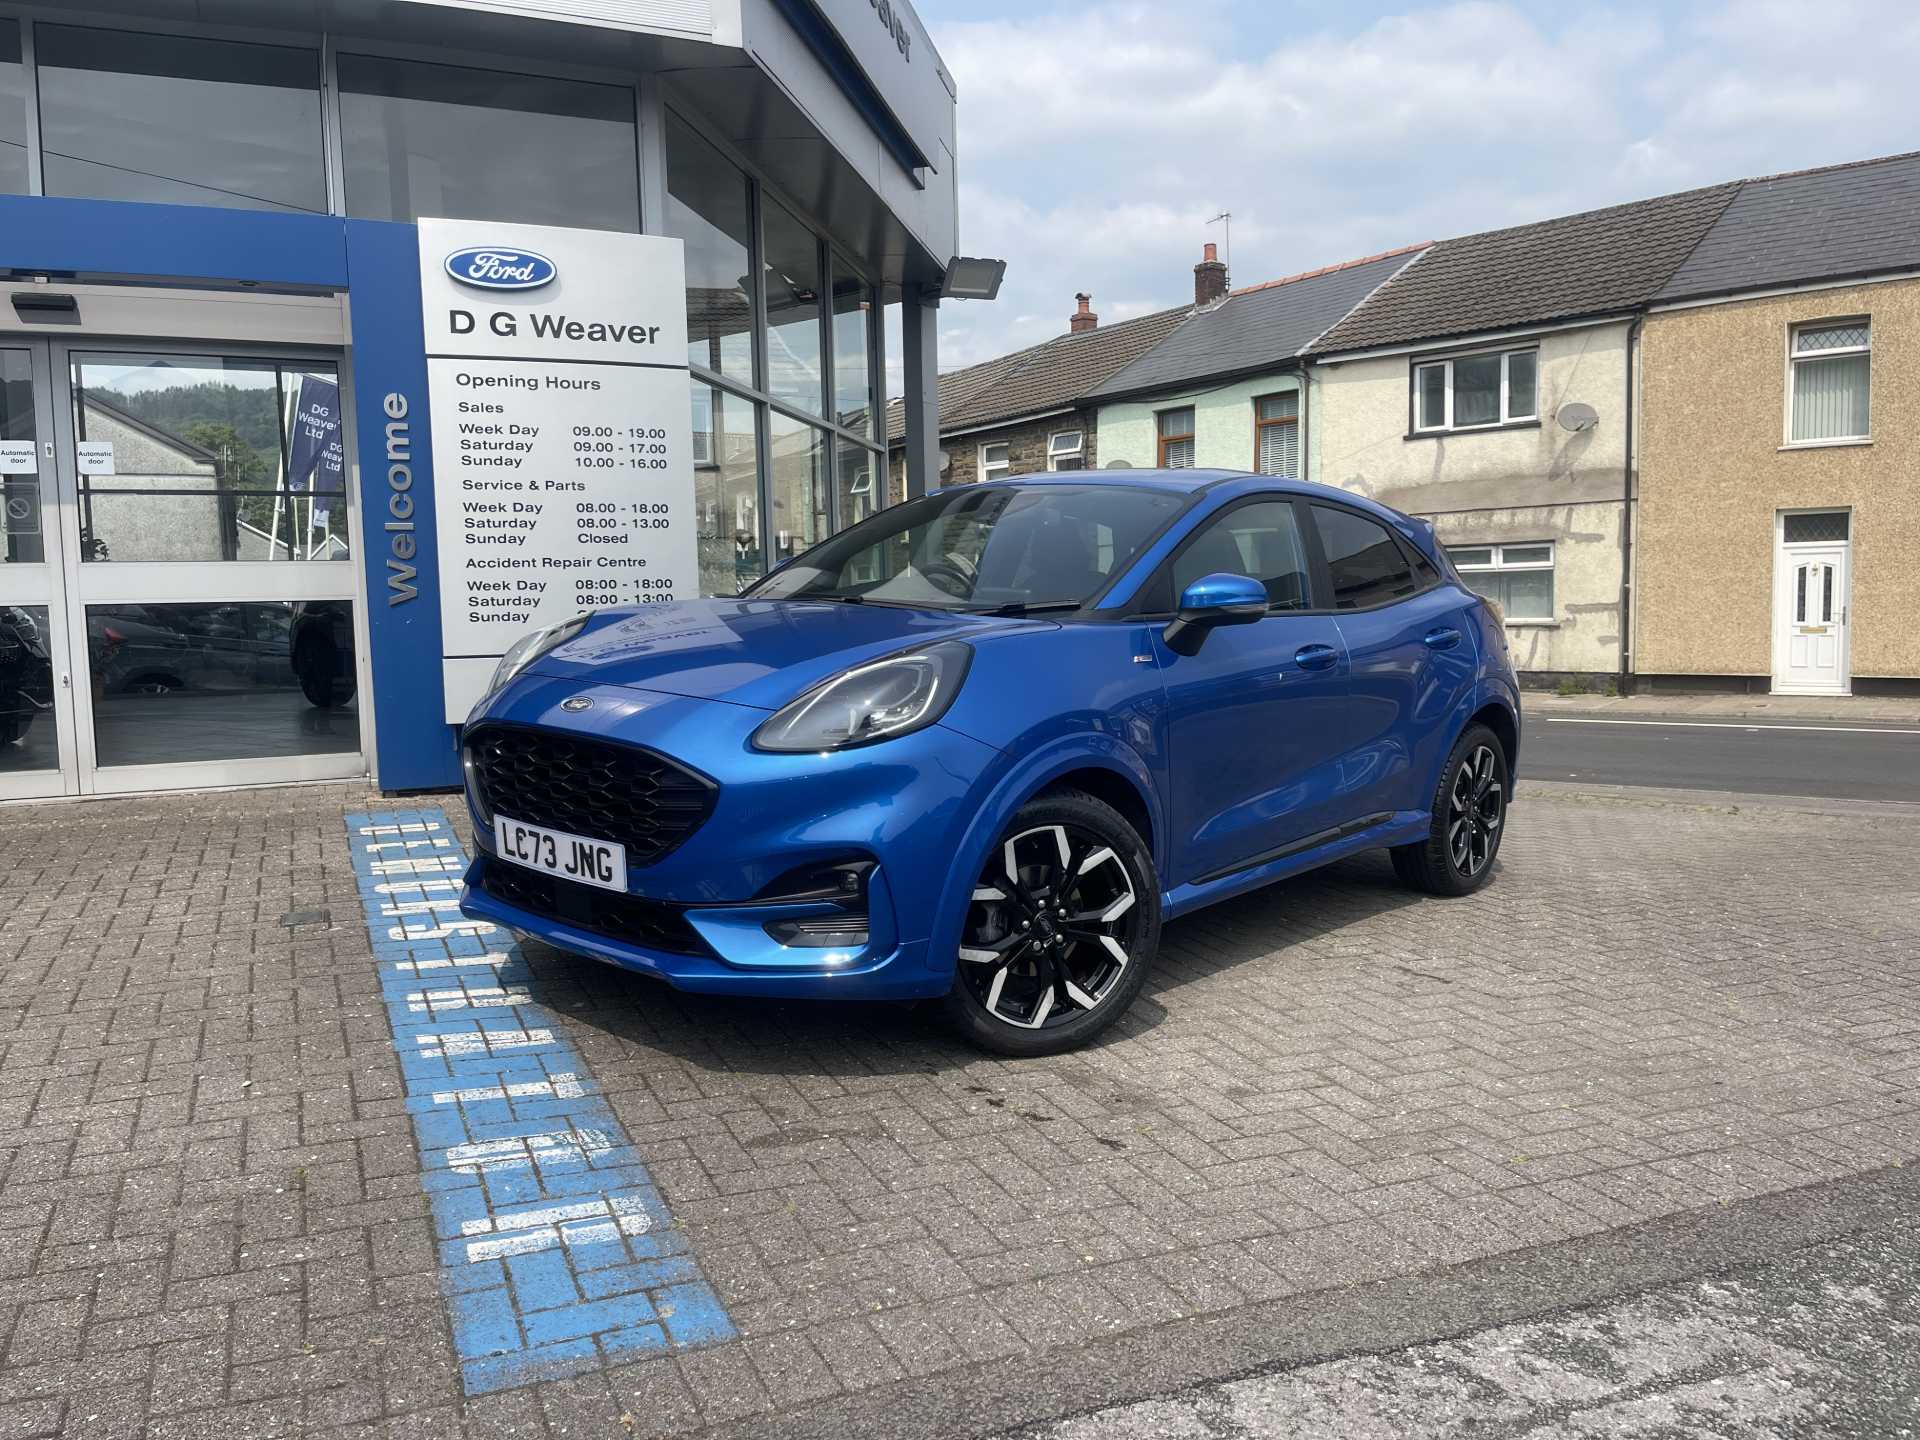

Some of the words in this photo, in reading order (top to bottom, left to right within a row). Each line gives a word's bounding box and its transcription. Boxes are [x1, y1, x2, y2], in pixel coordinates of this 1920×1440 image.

[869, 0, 911, 64] aver
[468, 252, 536, 282] Ford
[449, 309, 476, 335] D
[489, 311, 518, 337] G
[529, 313, 661, 345] Weaver
[455, 372, 539, 391] Opening
[545, 375, 601, 391] Hours
[311, 403, 329, 417] DG
[458, 401, 504, 414] Sales
[304, 425, 325, 440] Ltd
[458, 423, 504, 435] Week
[509, 423, 540, 438] Day
[572, 425, 613, 438] 09.00
[628, 427, 666, 440] 19.00
[0, 449, 36, 457] Automatic
[78, 450, 113, 458] Automatic
[330, 442, 343, 453] DG
[460, 438, 534, 454] Saturday
[573, 441, 614, 453] 09.00
[629, 443, 667, 455] 17.00
[321, 449, 343, 462] Weav
[460, 454, 523, 469] Sunday
[575, 457, 615, 469] 10.00
[630, 458, 668, 470] 16.00
[326, 460, 341, 472] Ltd
[462, 479, 524, 491] Service
[528, 480, 540, 491] &
[544, 479, 586, 492] Parts
[383, 392, 418, 608] Welcome
[461, 501, 508, 513] Week
[512, 502, 543, 515] Day
[575, 502, 617, 514] 08.00
[631, 503, 669, 514] 18.00
[464, 517, 537, 531] Saturday
[576, 517, 617, 529] 08.00
[631, 518, 670, 529] 13.00
[465, 532, 527, 547] Sunday
[577, 532, 629, 545] Closed
[465, 557, 537, 570] Accident
[541, 557, 593, 571] Repair
[596, 556, 647, 569] Centre
[466, 580, 512, 592] Week
[516, 580, 548, 593] Day
[575, 579, 618, 590] 08:00
[633, 578, 673, 590] 18:00
[468, 595, 541, 609] Saturday
[575, 594, 618, 605] 08:00
[634, 593, 674, 604] 13:00
[468, 611, 531, 624] Sunday
[502, 822, 557, 869] LC73
[564, 841, 613, 883] JNG
